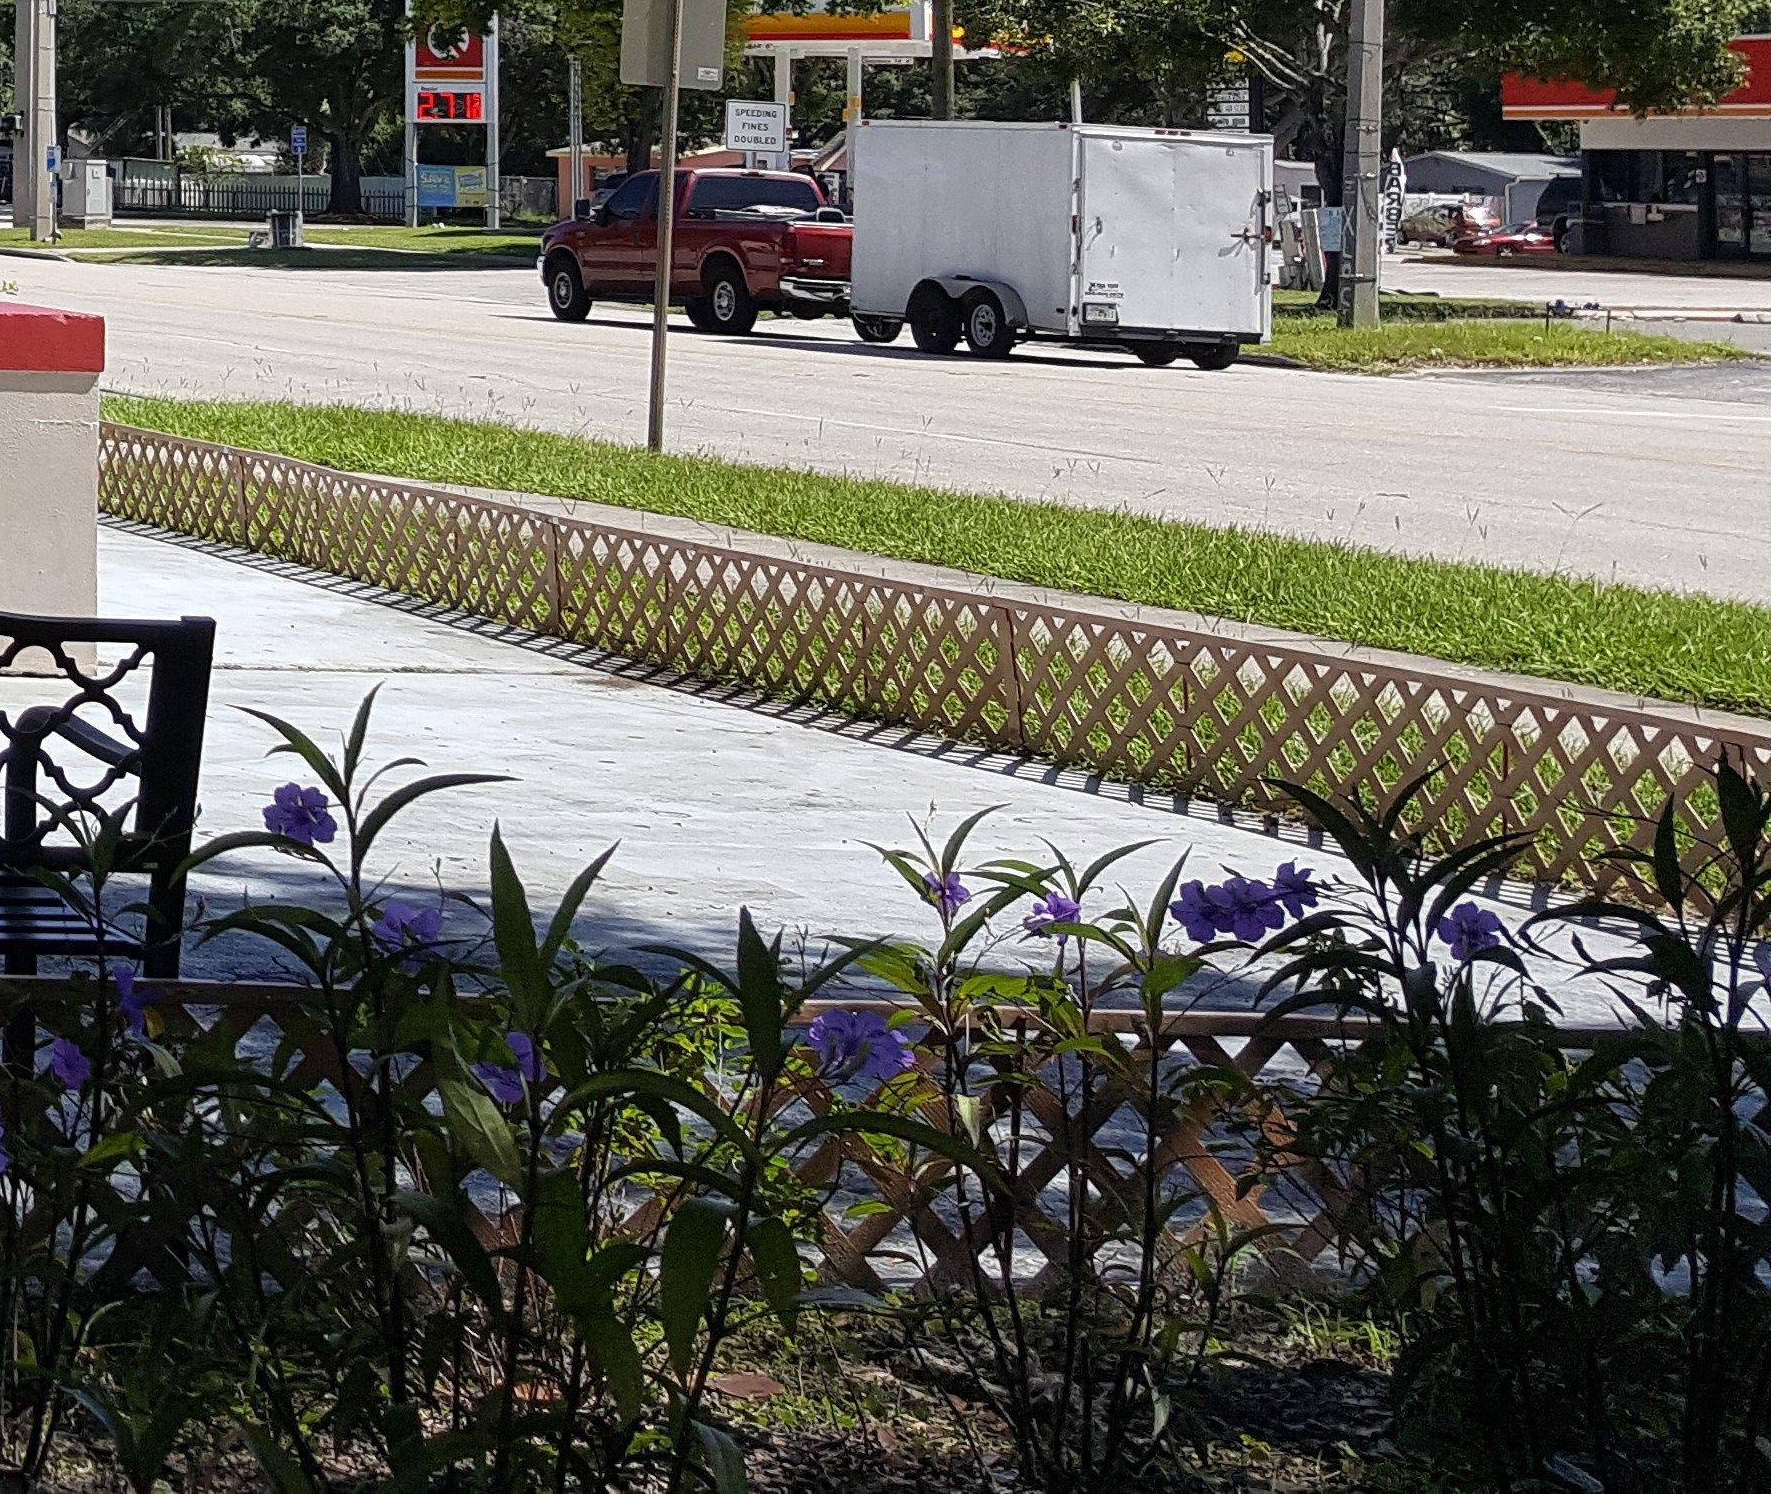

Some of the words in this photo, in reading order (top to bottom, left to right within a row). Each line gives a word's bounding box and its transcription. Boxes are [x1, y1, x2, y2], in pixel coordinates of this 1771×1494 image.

[735, 108, 777, 118] SPEEDING
[742, 122, 769, 131] FINES
[734, 135, 777, 145] DOUBLED
